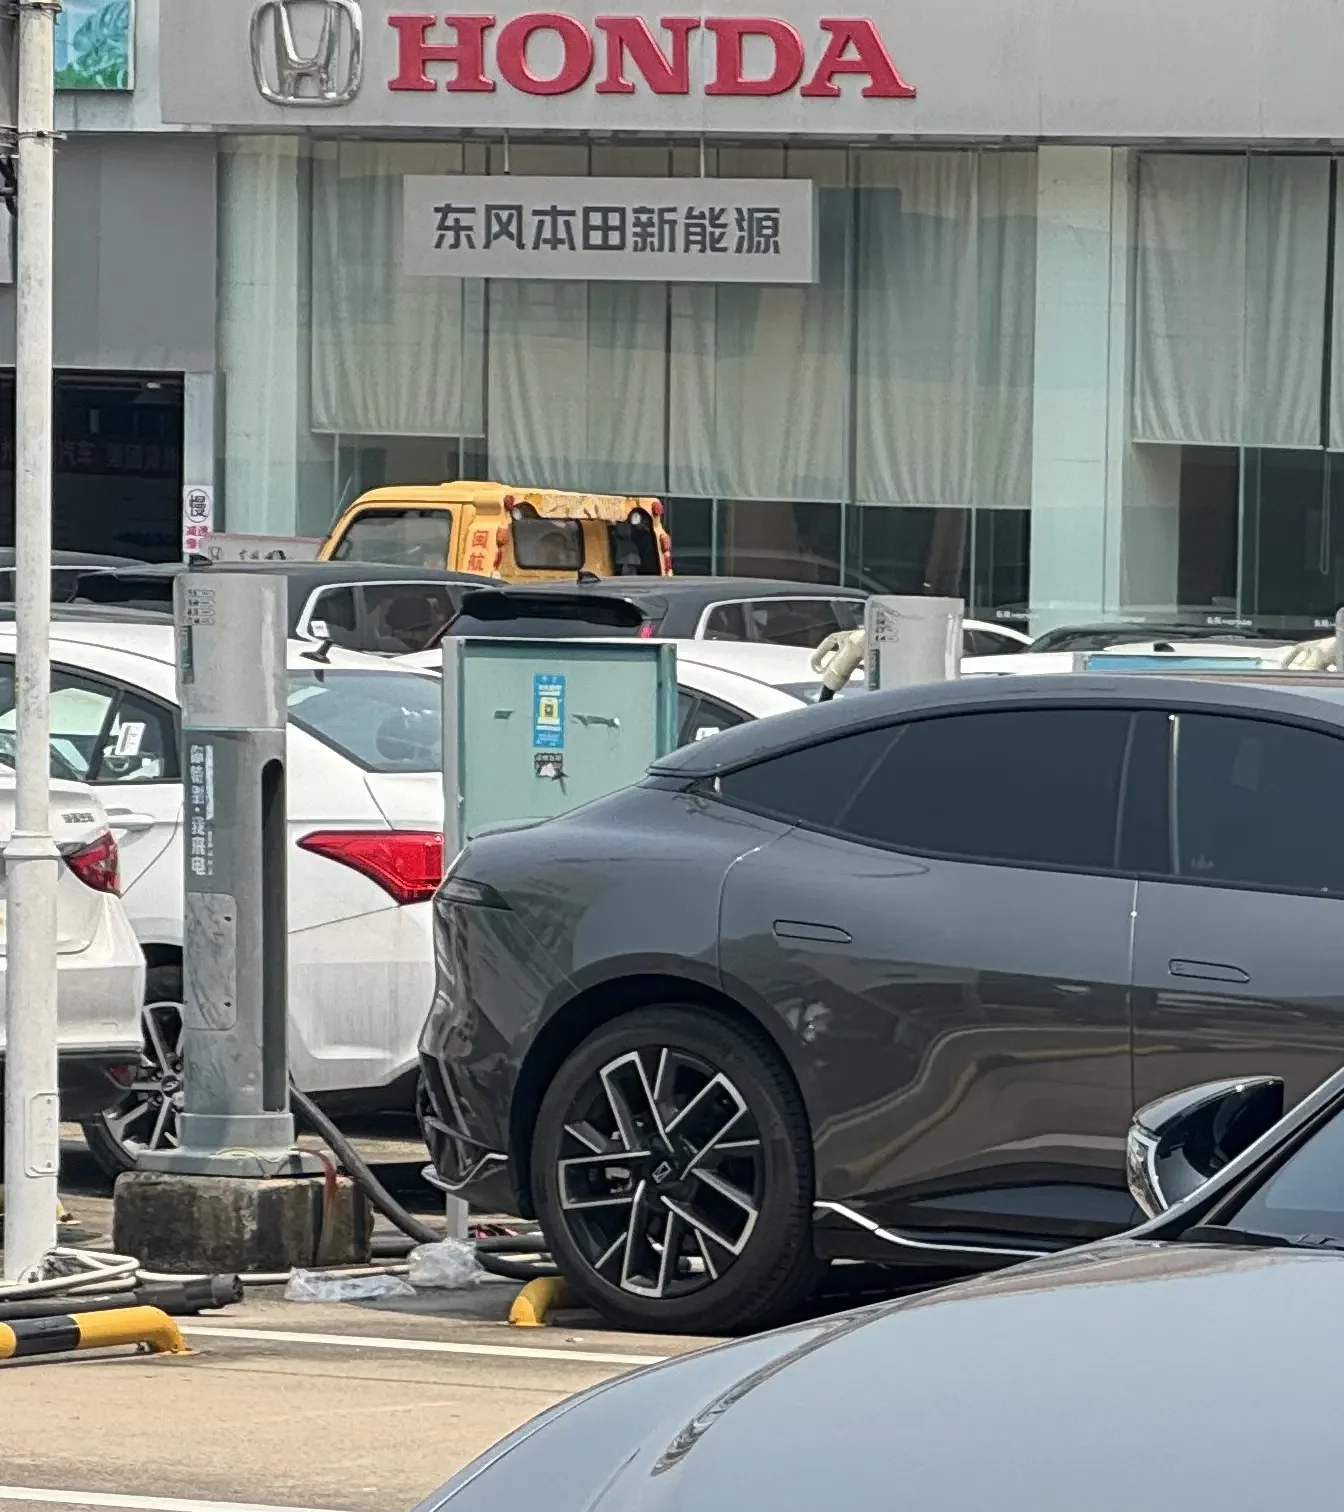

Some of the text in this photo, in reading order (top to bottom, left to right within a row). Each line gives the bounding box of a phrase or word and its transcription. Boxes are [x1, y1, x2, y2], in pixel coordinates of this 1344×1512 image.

[388, 13, 916, 99] HONDA
[433, 203, 781, 255] 东风本田新能源
